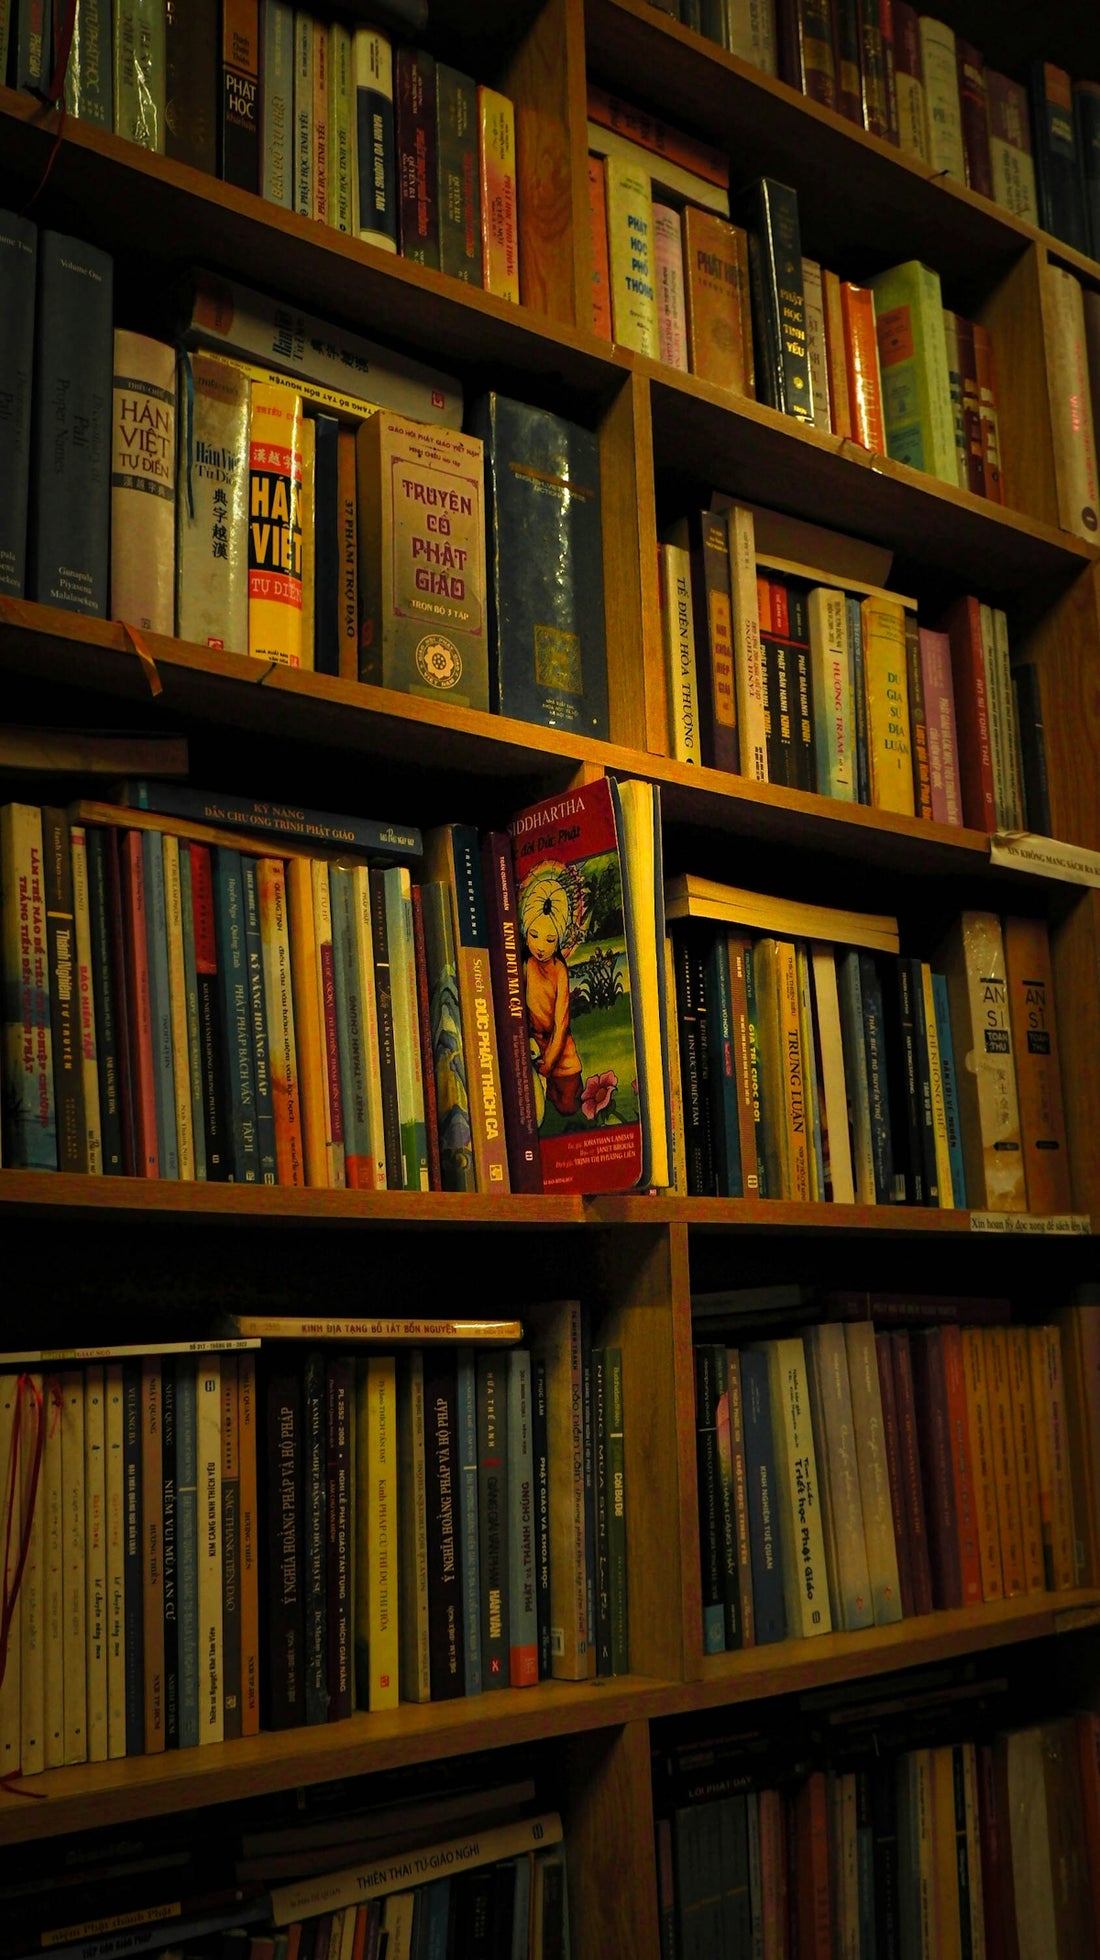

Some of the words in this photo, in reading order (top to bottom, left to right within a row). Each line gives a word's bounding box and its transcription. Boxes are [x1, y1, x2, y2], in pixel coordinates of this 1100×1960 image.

[299, 160, 310, 178] HỌC
[317, 169, 327, 189] HỌC
[298, 180, 310, 205] PHẬT
[316, 189, 328, 215] PHẬT
[627, 214, 649, 236] PHẬT
[630, 236, 649, 256] HỌC
[60, 258, 87, 277] Volume
[631, 256, 649, 278] PHỔ
[625, 275, 654, 302] THÔNG
[783, 305, 803, 323] HỌC
[786, 340, 805, 359] YẾU
[52, 378, 71, 421] Proper
[120, 399, 169, 433] HÁN
[119, 425, 171, 459] VIỆT
[119, 453, 140, 470] TỰ
[141, 455, 169, 479] ĐIỂN
[252, 475, 302, 529] HÁN
[345, 499, 353, 515] 37
[402, 479, 473, 515] TRUYỆN
[426, 510, 451, 537] CỔ
[252, 521, 303, 574] VIỆT
[345, 519, 356, 564] PHẨM
[412, 536, 467, 571] PHẬT
[251, 577, 272, 593] TỰ
[344, 567, 356, 601] TRỢ
[415, 567, 466, 601] GIÁO
[676, 577, 690, 596] TẾ
[344, 604, 356, 638] ĐẠO
[411, 598, 433, 613] TRỌN
[433, 602, 446, 615] BỘ
[453, 608, 470, 622] TẬP
[679, 642, 691, 676] HÒA
[681, 682, 695, 749] THƯỢNG
[780, 714, 791, 738] KINH
[204, 803, 226, 819] DẪN
[226, 809, 272, 827] CHƯƠNG
[273, 817, 305, 832] TRÌNH
[305, 822, 331, 837] PHẬT
[331, 826, 356, 842] GIÁO
[1007, 846, 1020, 856] XIN
[1020, 848, 1045, 862] KHÔNG
[1045, 855, 1066, 868] MANG
[502, 921, 518, 949] KINH
[249, 951, 260, 970] KỸ
[503, 952, 519, 977] DUY
[233, 983, 247, 1015] PHẬT
[251, 973, 263, 1008] NĂNG
[506, 977, 520, 995] MA
[983, 985, 1006, 1004] AN
[1025, 987, 1046, 1006] AN
[474, 997, 490, 1030] ĐỨC
[506, 996, 523, 1018] CẬT
[235, 1016, 250, 1046] PHÁP
[251, 1012, 266, 1058] HOẰNG
[476, 1031, 494, 1068] PHẬT
[787, 1029, 802, 1087] TRUNG
[237, 1047, 251, 1080] BÁCH
[930, 1047, 943, 1105] KHÔNG
[256, 1060, 268, 1096] PHÁP
[240, 1081, 254, 1105] VẤN
[479, 1068, 497, 1116] THÍCH
[786, 1091, 804, 1134] LUẬN
[240, 1120, 254, 1141] TẬP
[485, 1117, 499, 1140] CA
[244, 1142, 254, 1152] II
[301, 1324, 323, 1333] KINH
[326, 1324, 342, 1335] ĐỊA
[344, 1324, 368, 1335] TẠNG
[371, 1322, 383, 1334] BỒ
[385, 1322, 402, 1333] TÁT
[404, 1322, 421, 1333] BỔN
[165, 1409, 174, 1445] QUANG
[276, 1406, 294, 1436] PHÁP
[280, 1438, 296, 1457] HỘ
[486, 1425, 496, 1448] ANH
[205, 1462, 215, 1477] YẾU
[279, 1459, 295, 1476] VÀ
[759, 1465, 768, 1488] KINH
[794, 1458, 806, 1495] Triết
[163, 1479, 176, 1514] NIỀM
[206, 1478, 216, 1500] THÍCH
[279, 1478, 295, 1510] PHÁP
[207, 1500, 215, 1519] KINH
[598, 1495, 606, 1537] SEN
[760, 1488, 772, 1524] NGHIỆM
[796, 1497, 808, 1524] học
[164, 1517, 176, 1542] VUI
[207, 1519, 216, 1541] CANG
[277, 1511, 296, 1554] HOẰNG
[208, 1541, 216, 1557] KIM
[800, 1527, 811, 1563] Phật
[165, 1545, 177, 1576] MÙA
[282, 1556, 297, 1595] NGHĨA
[805, 1566, 815, 1601] Giáo
[165, 1581, 176, 1599] AN
[281, 1596, 297, 1605] Ý
[488, 1589, 501, 1614] HÁN
[165, 1601, 177, 1621] CƯ
[489, 1613, 502, 1638] VĂN
[429, 1852, 454, 1870] GIÁO
